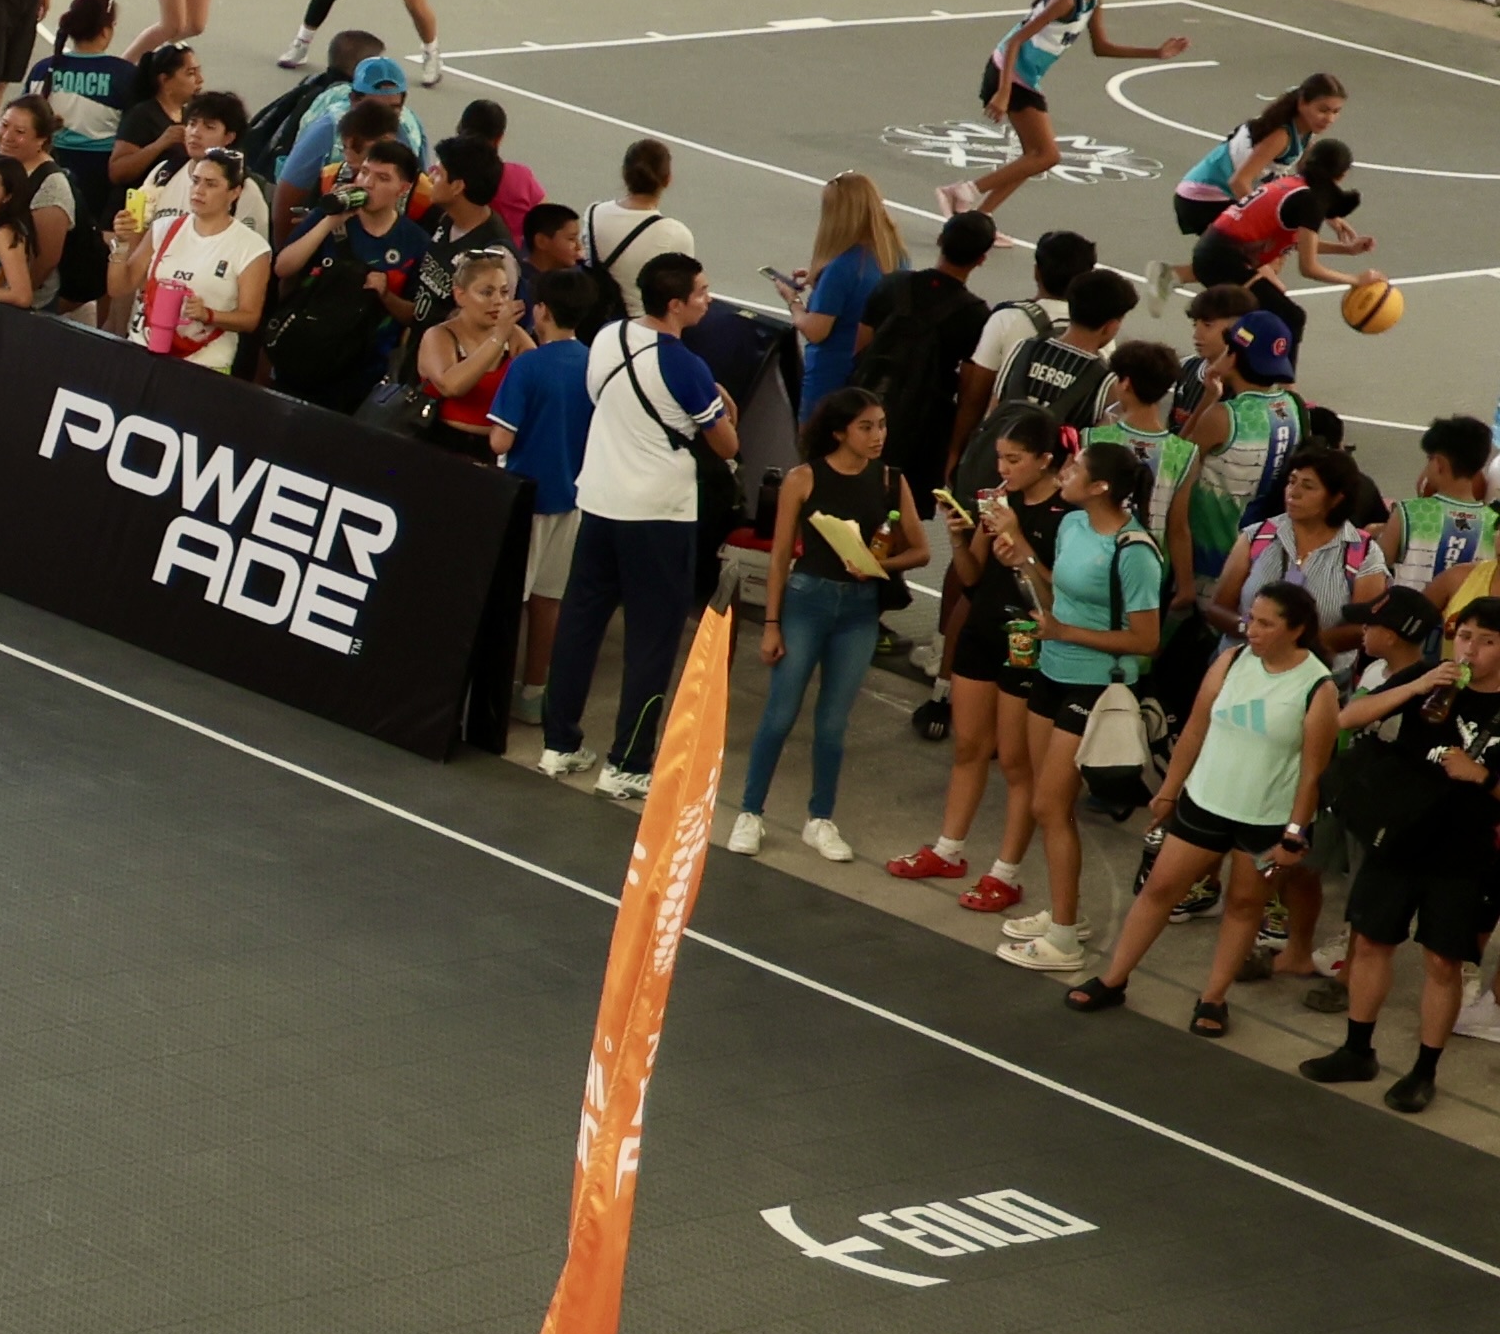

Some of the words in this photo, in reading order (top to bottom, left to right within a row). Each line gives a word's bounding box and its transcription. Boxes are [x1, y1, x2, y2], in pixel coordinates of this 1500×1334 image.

[52, 71, 111, 97] COACH
[38, 386, 398, 580] POWER
[151, 514, 369, 655] ADE
